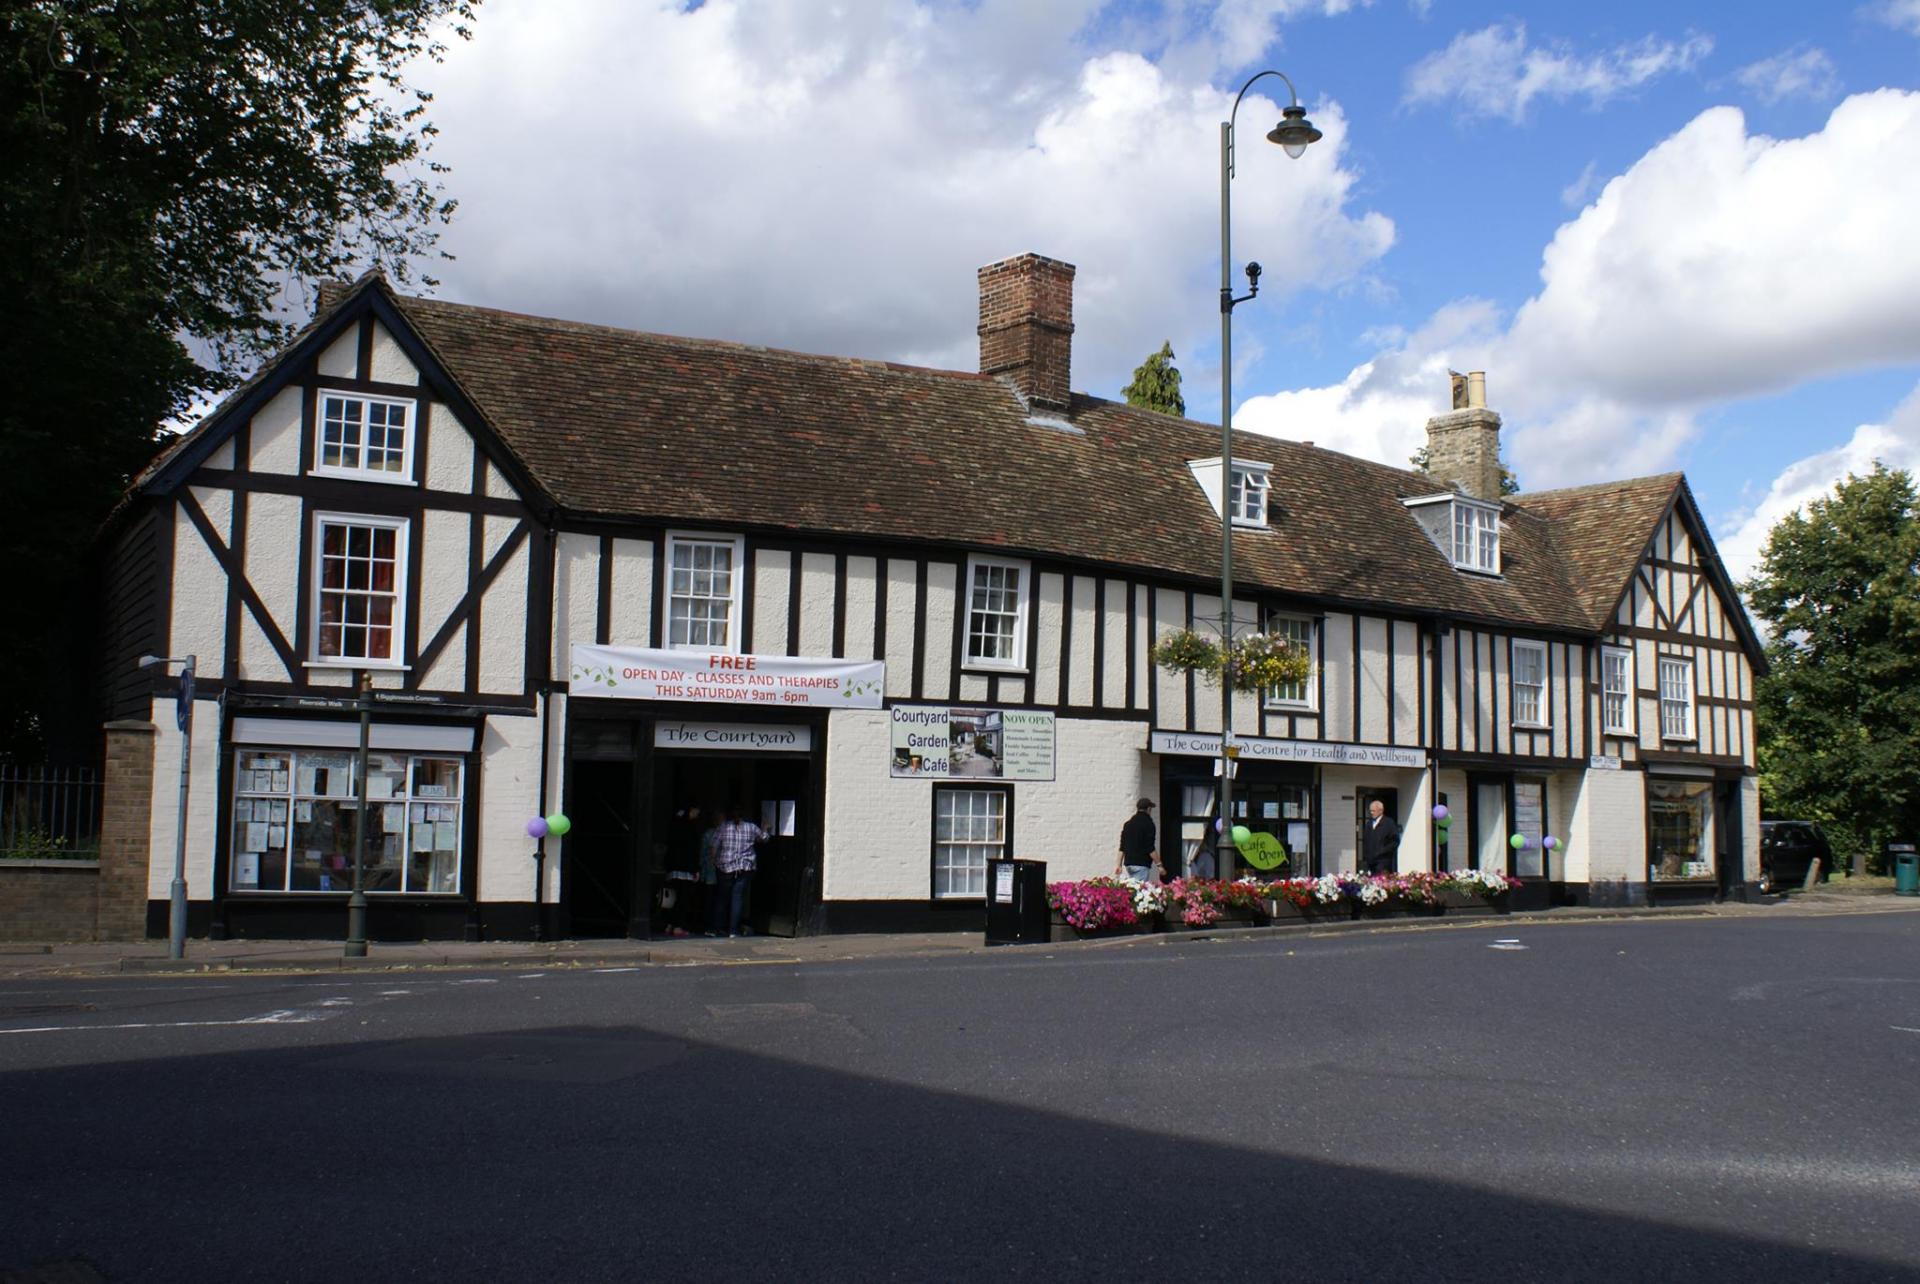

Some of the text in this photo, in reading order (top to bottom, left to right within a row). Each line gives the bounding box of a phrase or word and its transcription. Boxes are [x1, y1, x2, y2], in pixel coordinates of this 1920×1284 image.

[709, 655, 756, 670] FREE
[623, 668, 656, 680] OPEN
[661, 670, 684, 681] DAY
[696, 672, 745, 685] CLASSES
[748, 675, 774, 686] AND
[777, 676, 839, 689] THERAPIES
[656, 685, 683, 697] THIS
[686, 686, 748, 699] SATURDAY
[752, 690, 776, 701] 9am
[893, 709, 948, 727] Courtyard
[1005, 715, 1052, 724] NOW OPEN
[664, 723, 796, 747] The Courtyard
[908, 733, 948, 748] Garden
[1165, 734, 1416, 765] The Courrd Centre for Health and Wellbeing
[923, 757, 948, 772] Café
